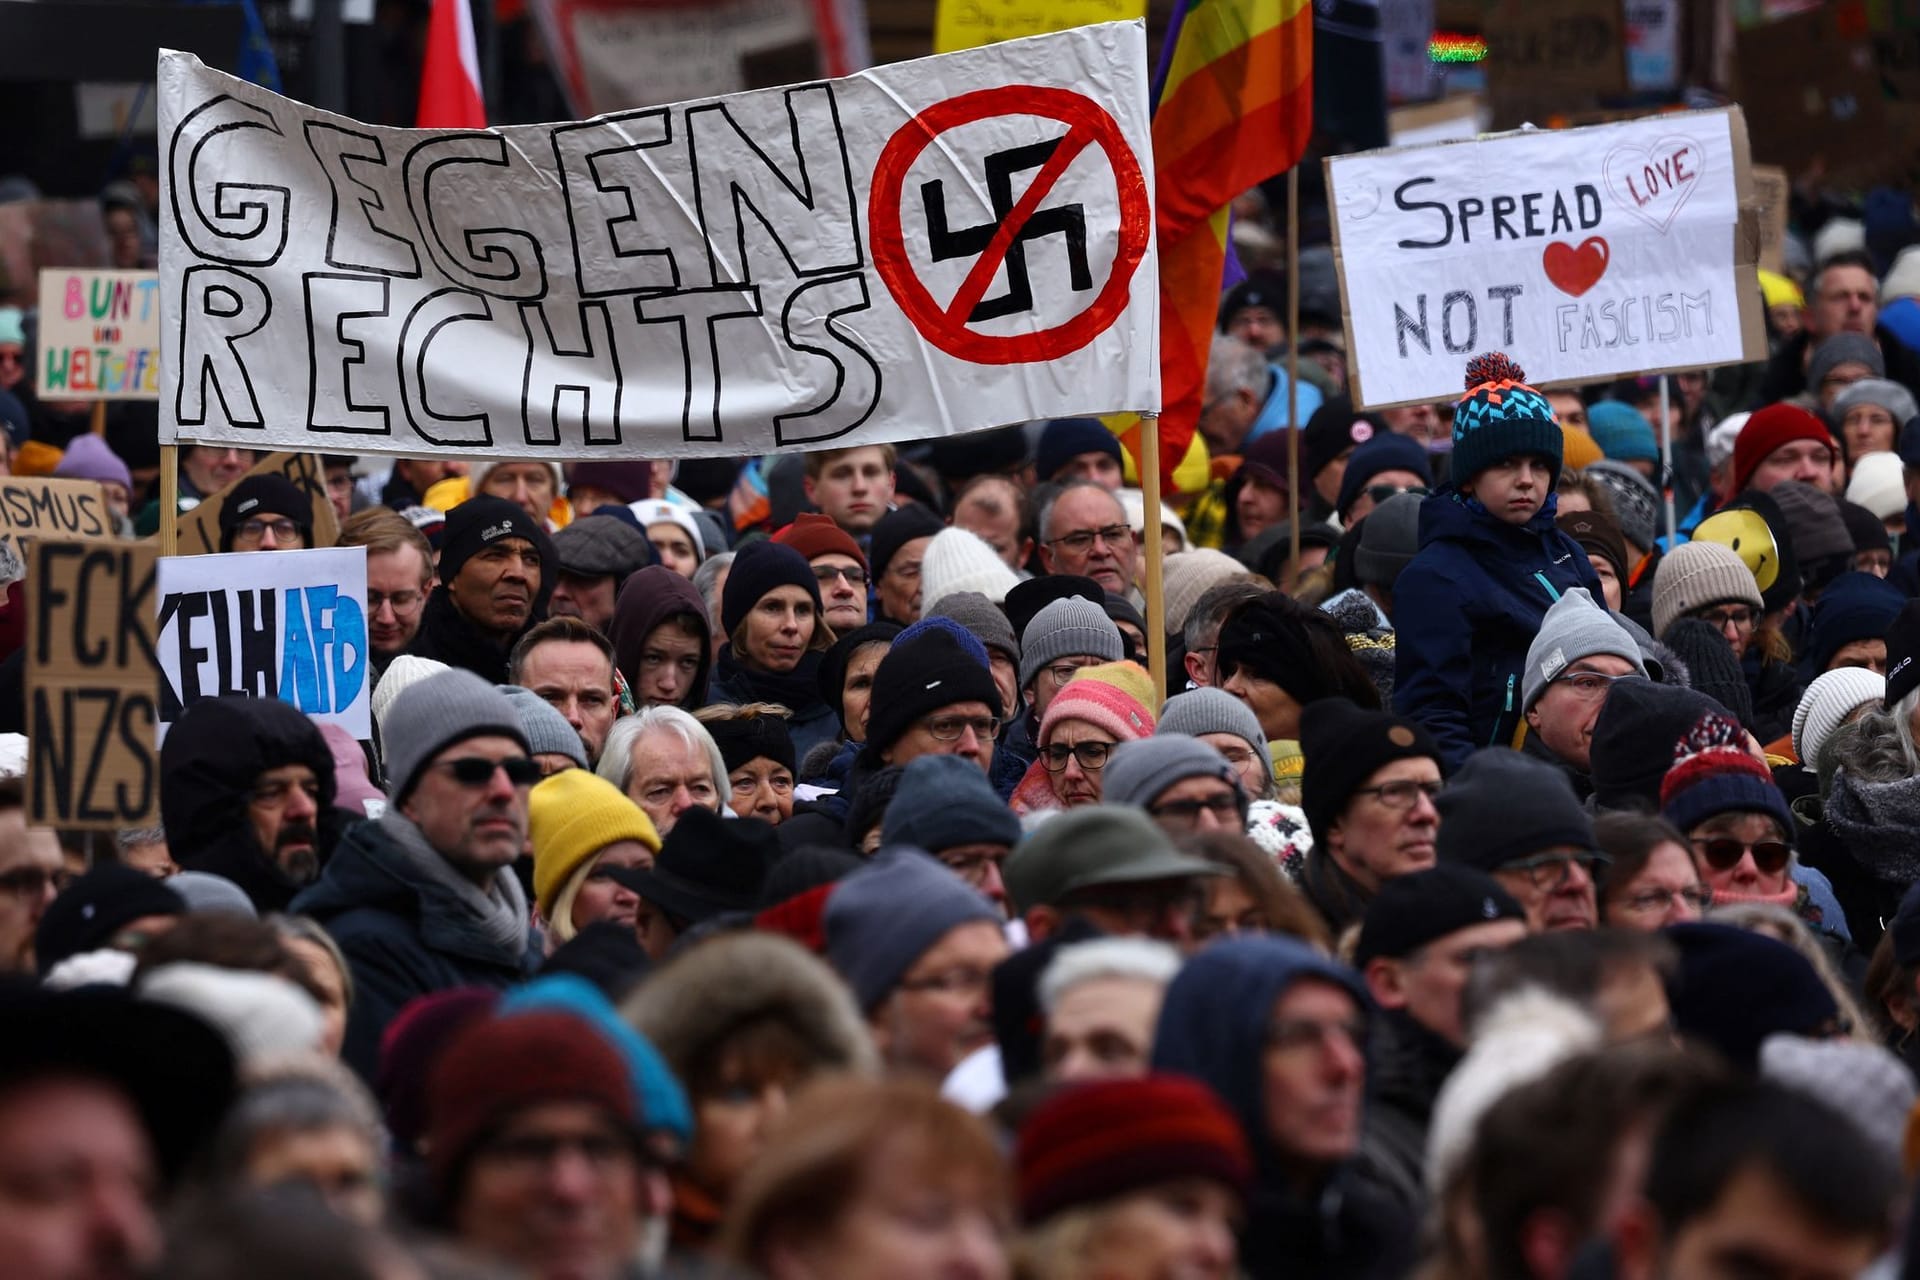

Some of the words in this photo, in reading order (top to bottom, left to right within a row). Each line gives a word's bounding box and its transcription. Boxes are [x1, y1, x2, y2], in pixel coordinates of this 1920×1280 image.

[169, 82, 864, 300] GEGEN
[1393, 177, 1602, 249] SPREAD
[1626, 147, 1695, 207] LOVE
[63, 275, 160, 321] BUNT
[176, 264, 882, 447] RECHTS
[1393, 284, 1524, 358] NOT
[1555, 289, 1714, 352] FASCISM
[37, 543, 158, 668] FCK
[32, 685, 155, 821] NZS
